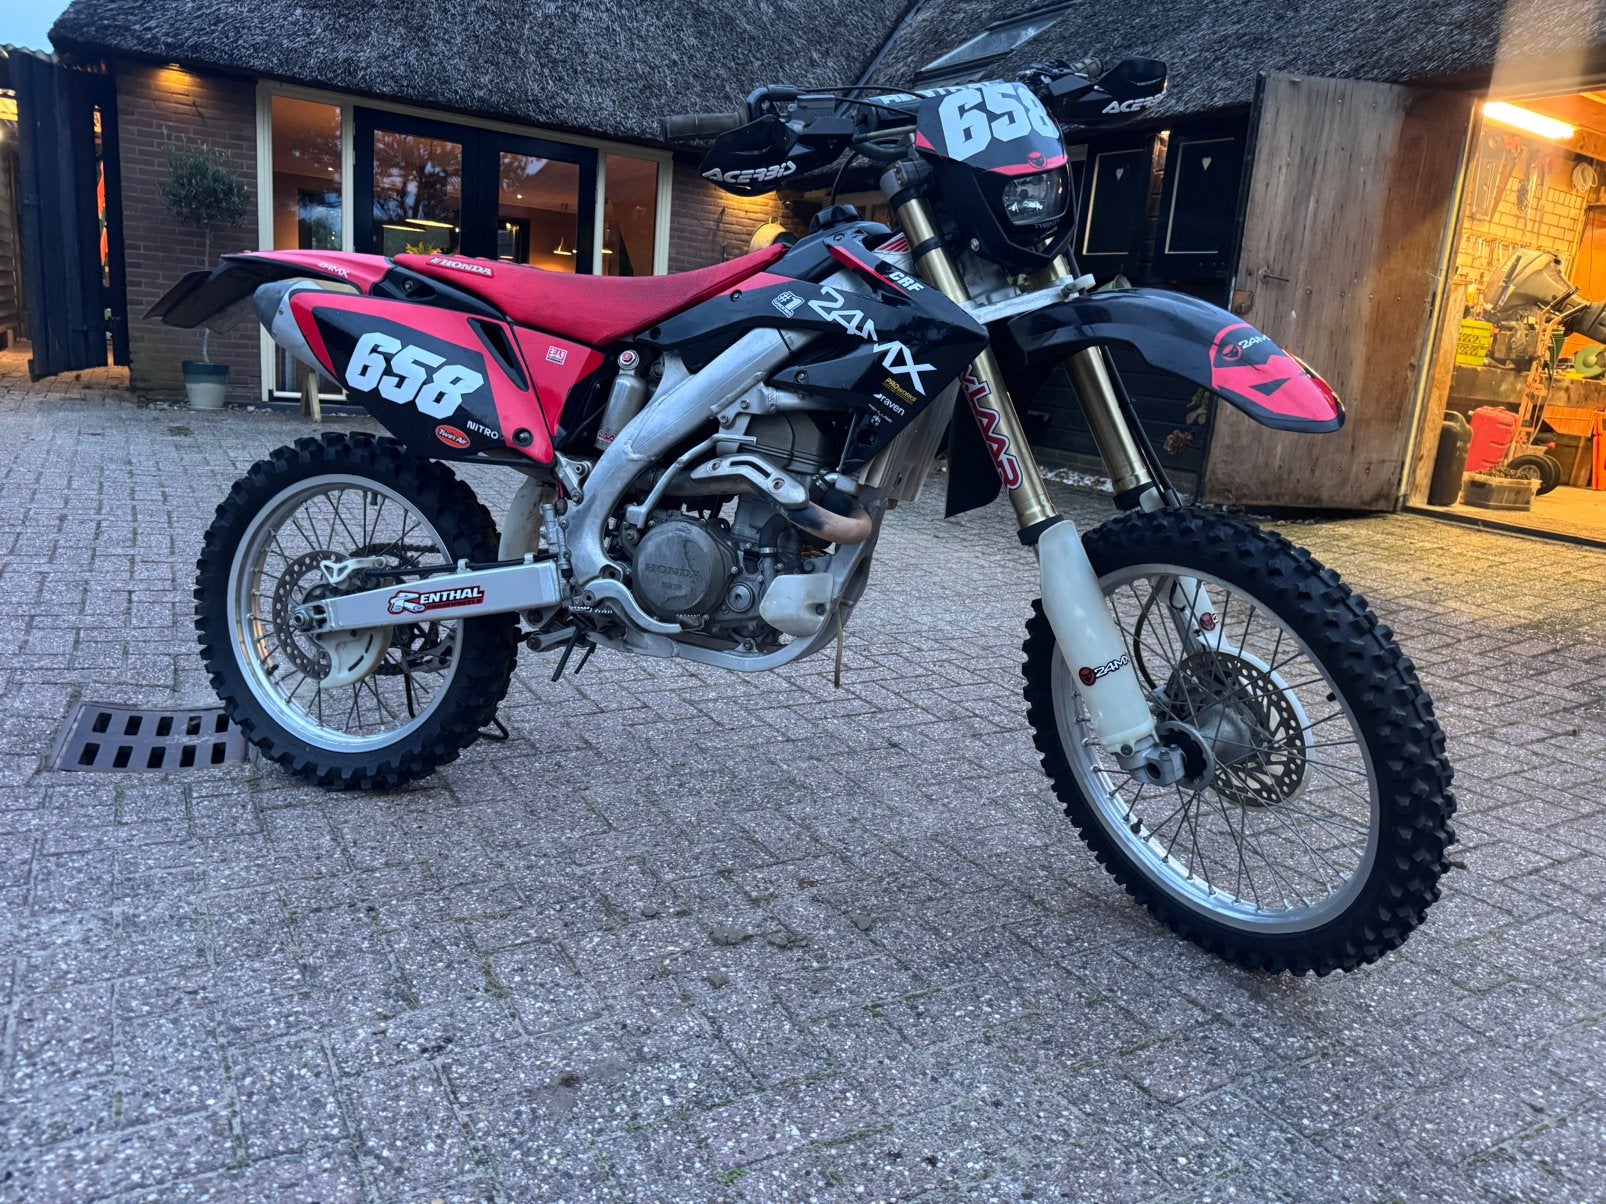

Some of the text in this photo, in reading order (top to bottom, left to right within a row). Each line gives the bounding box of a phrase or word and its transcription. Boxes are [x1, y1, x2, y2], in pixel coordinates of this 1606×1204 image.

[938, 81, 1060, 162] 658
[440, 258, 494, 277] HONDA
[888, 271, 925, 291] CRF
[807, 285, 938, 397] 24MX
[1238, 334, 1272, 349] 24M
[344, 332, 485, 420] 658
[880, 394, 905, 417] raven
[439, 428, 468, 445] Twin Air
[466, 420, 499, 440] NITRO
[644, 563, 701, 581] HONDA
[390, 587, 483, 613] RENTHAL
